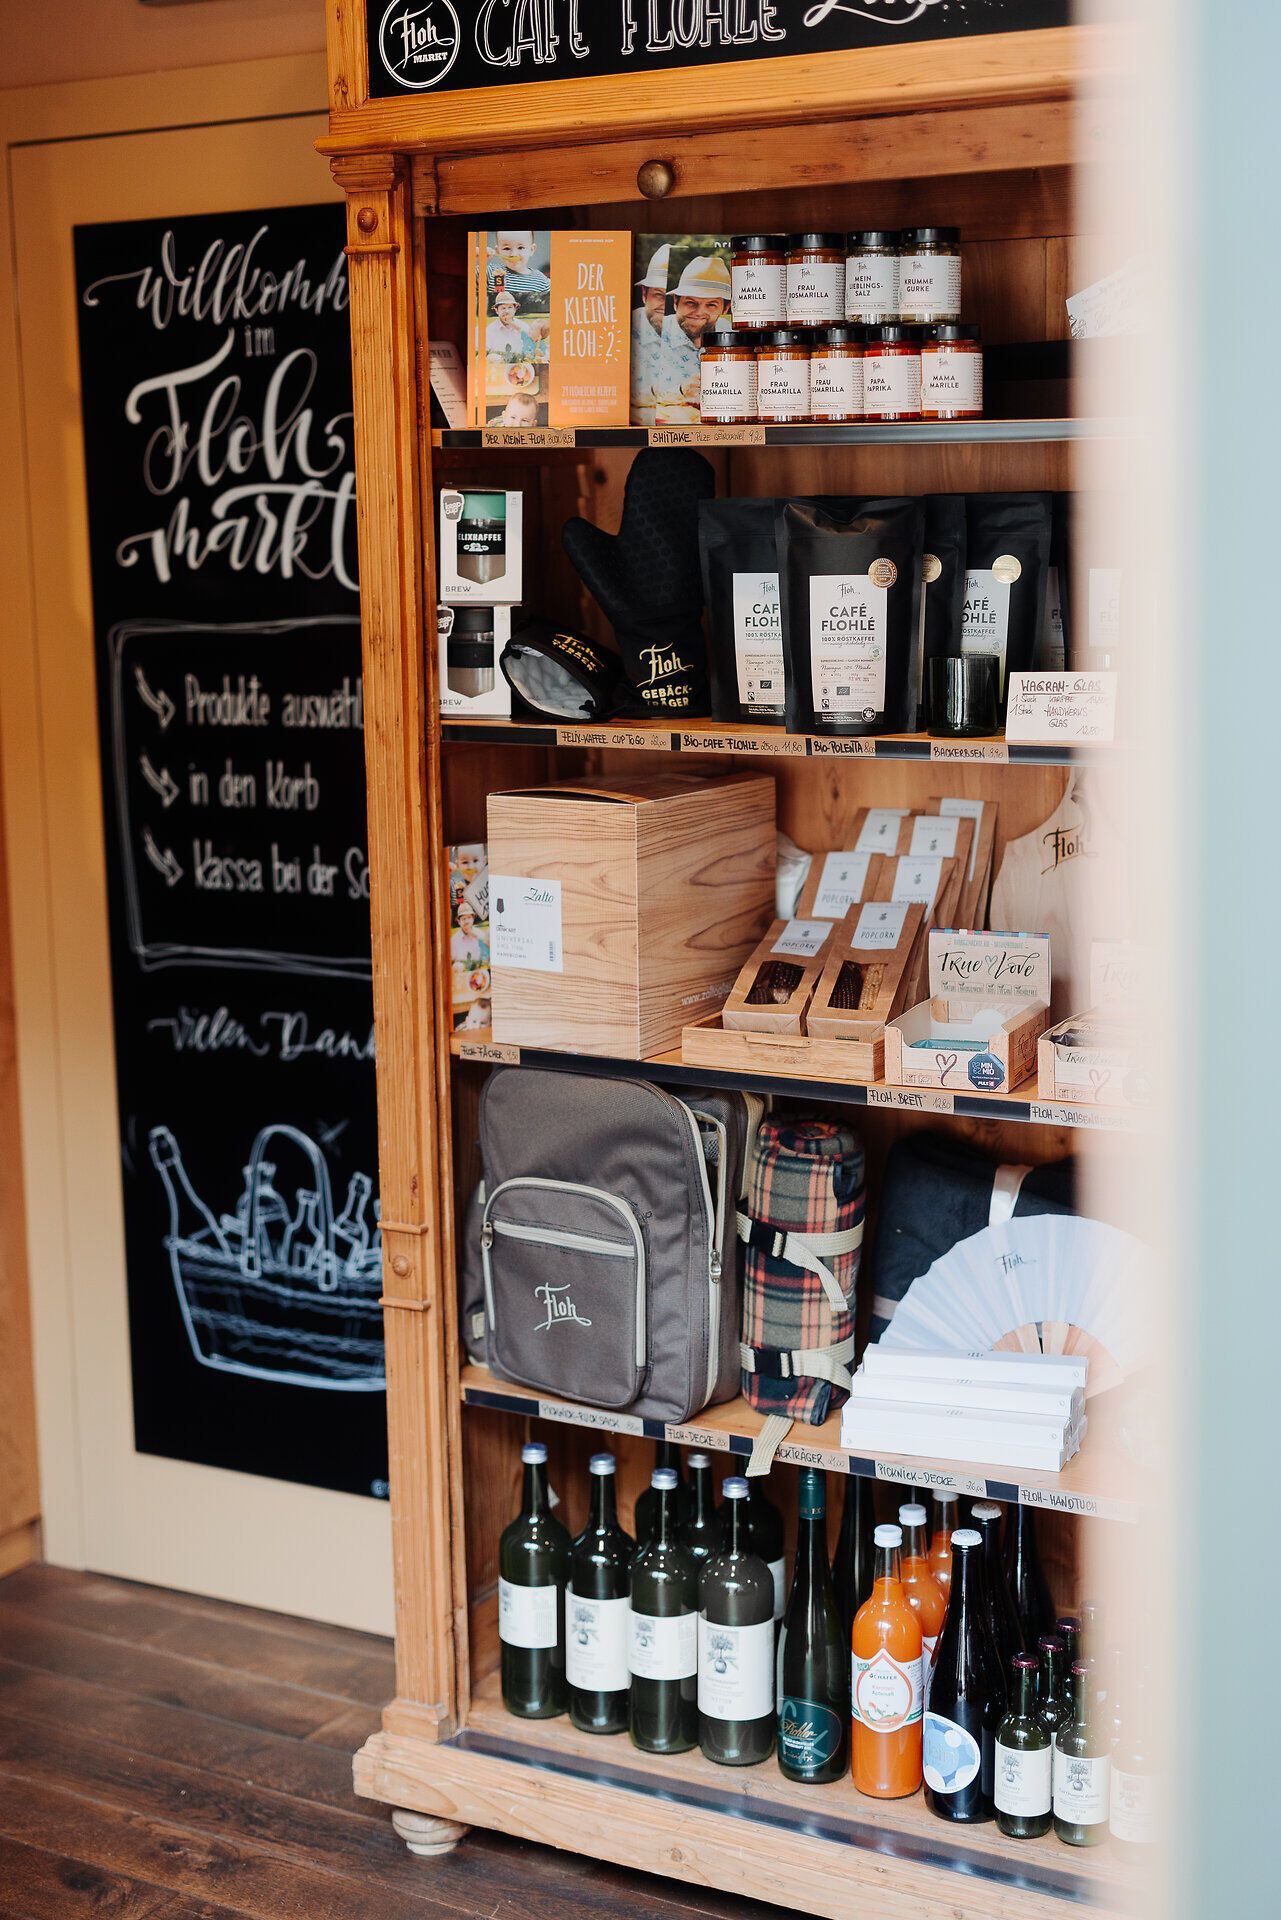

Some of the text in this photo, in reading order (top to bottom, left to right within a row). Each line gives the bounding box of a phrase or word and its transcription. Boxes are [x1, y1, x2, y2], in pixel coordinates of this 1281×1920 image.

[390, 2, 455, 70] Floh
[413, 52, 448, 63] MARKT
[577, 262, 604, 292] DER
[565, 295, 618, 325] KLEINE
[245, 325, 275, 357] im
[563, 329, 615, 357] FLOH 2
[836, 582, 855, 598] Floh
[821, 616, 875, 631] FLOHLÉ
[829, 602, 867, 617] CAFÉ
[636, 642, 694, 687] Floh
[185, 673, 270, 726] Produkte
[642, 685, 692, 699] GEBÄCK-
[188, 758, 320, 811] in den Korb
[193, 838, 264, 893] Kassa
[271, 842, 301, 895] bei
[307, 845, 338, 897] der
[523, 887, 554, 903] Zalto
[781, 941, 816, 950] POPCORN
[860, 931, 895, 940] POPCORN
[994, 951, 1041, 980] Love
[534, 1282, 592, 1331] Floh
